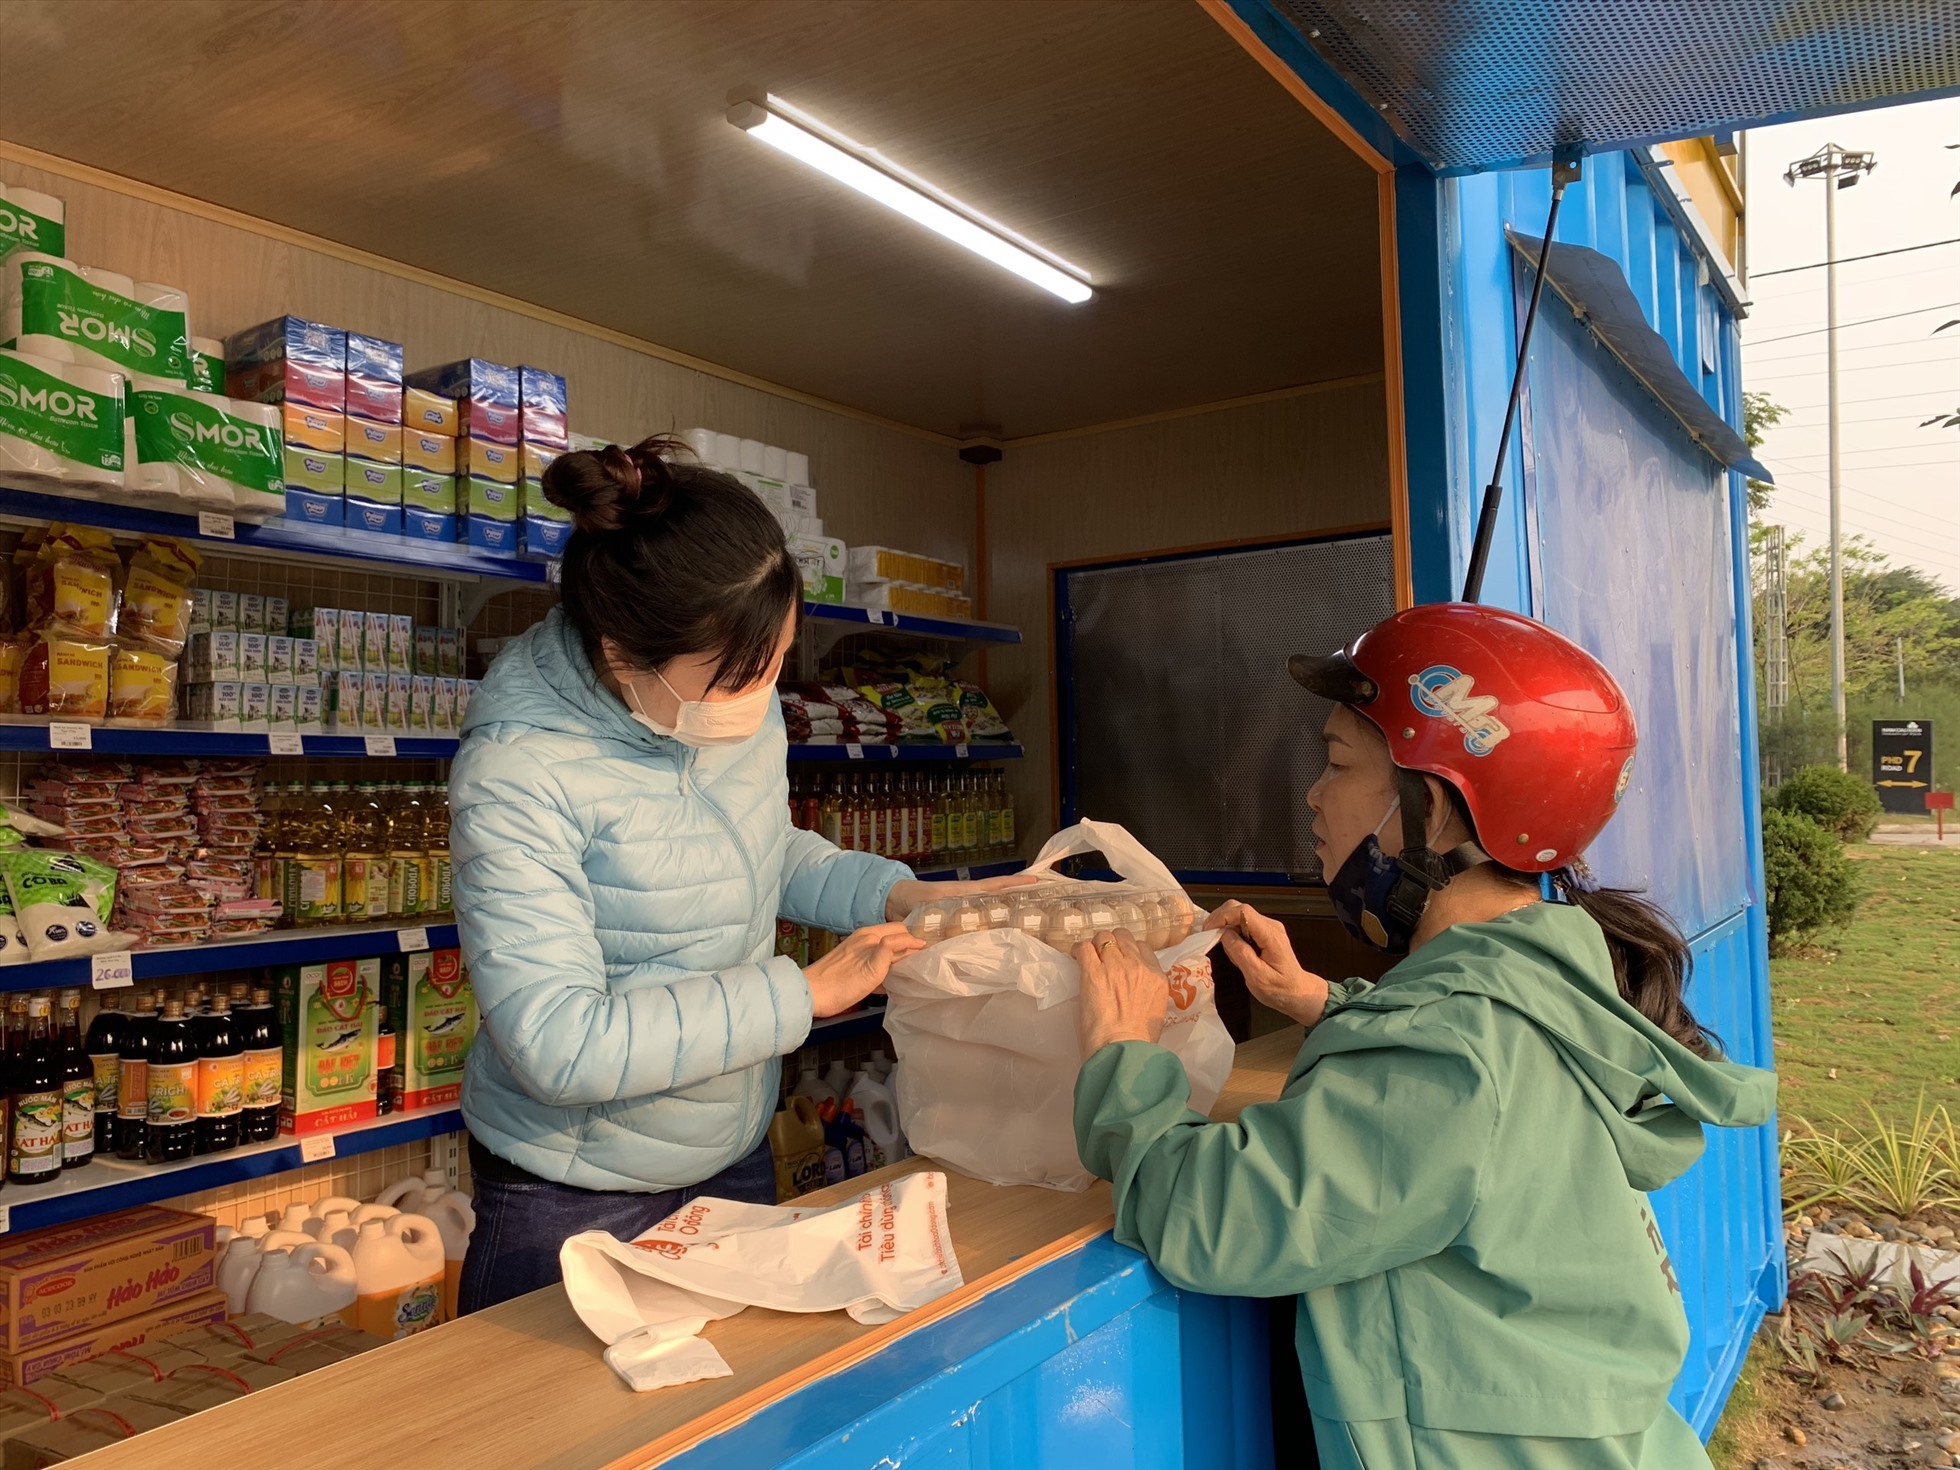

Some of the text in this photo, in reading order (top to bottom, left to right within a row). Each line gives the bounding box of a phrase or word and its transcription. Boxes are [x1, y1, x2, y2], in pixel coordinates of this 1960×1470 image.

[0, 209, 39, 240] OR
[58, 311, 157, 358] SMOR
[0, 374, 98, 421] SMOR
[170, 412, 263, 450] SMOR
[133, 582, 177, 600] SANDWICH
[57, 658, 103, 669] SANDWICH
[1904, 750, 1923, 773] 7
[95, 968, 131, 981] 26.000
[857, 1230, 873, 1251] Tài
[879, 1233, 896, 1262] Tiêu
[107, 1262, 180, 1310] Hảo Hảo
